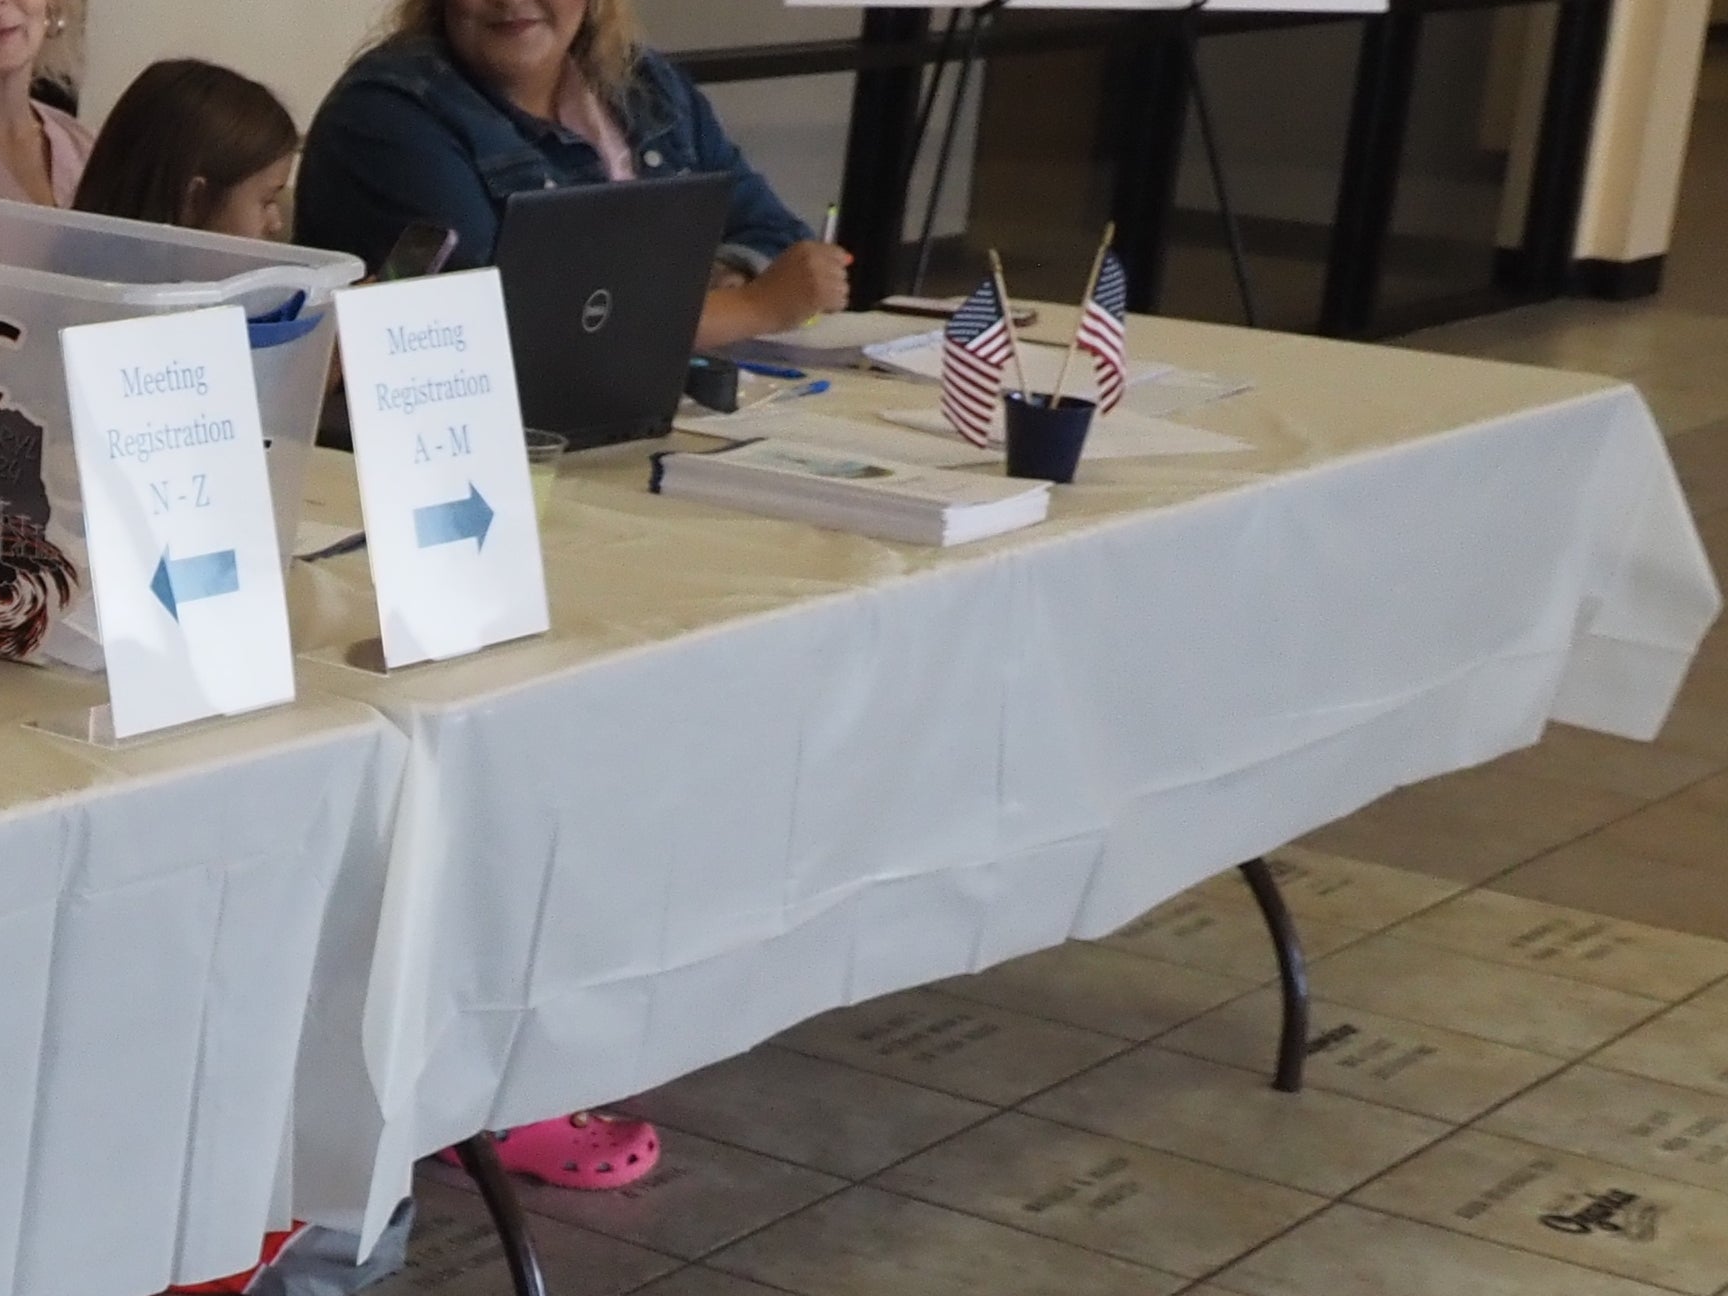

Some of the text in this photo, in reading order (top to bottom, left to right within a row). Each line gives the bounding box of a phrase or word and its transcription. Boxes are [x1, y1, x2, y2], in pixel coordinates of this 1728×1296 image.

[386, 320, 466, 356] Meeting
[120, 360, 206, 399] Meeting
[375, 370, 491, 414] Registration
[107, 414, 235, 463] Registration
[413, 434, 431, 464] A
[451, 425, 472, 457] M
[150, 481, 172, 515] N
[191, 474, 210, 508] Z
